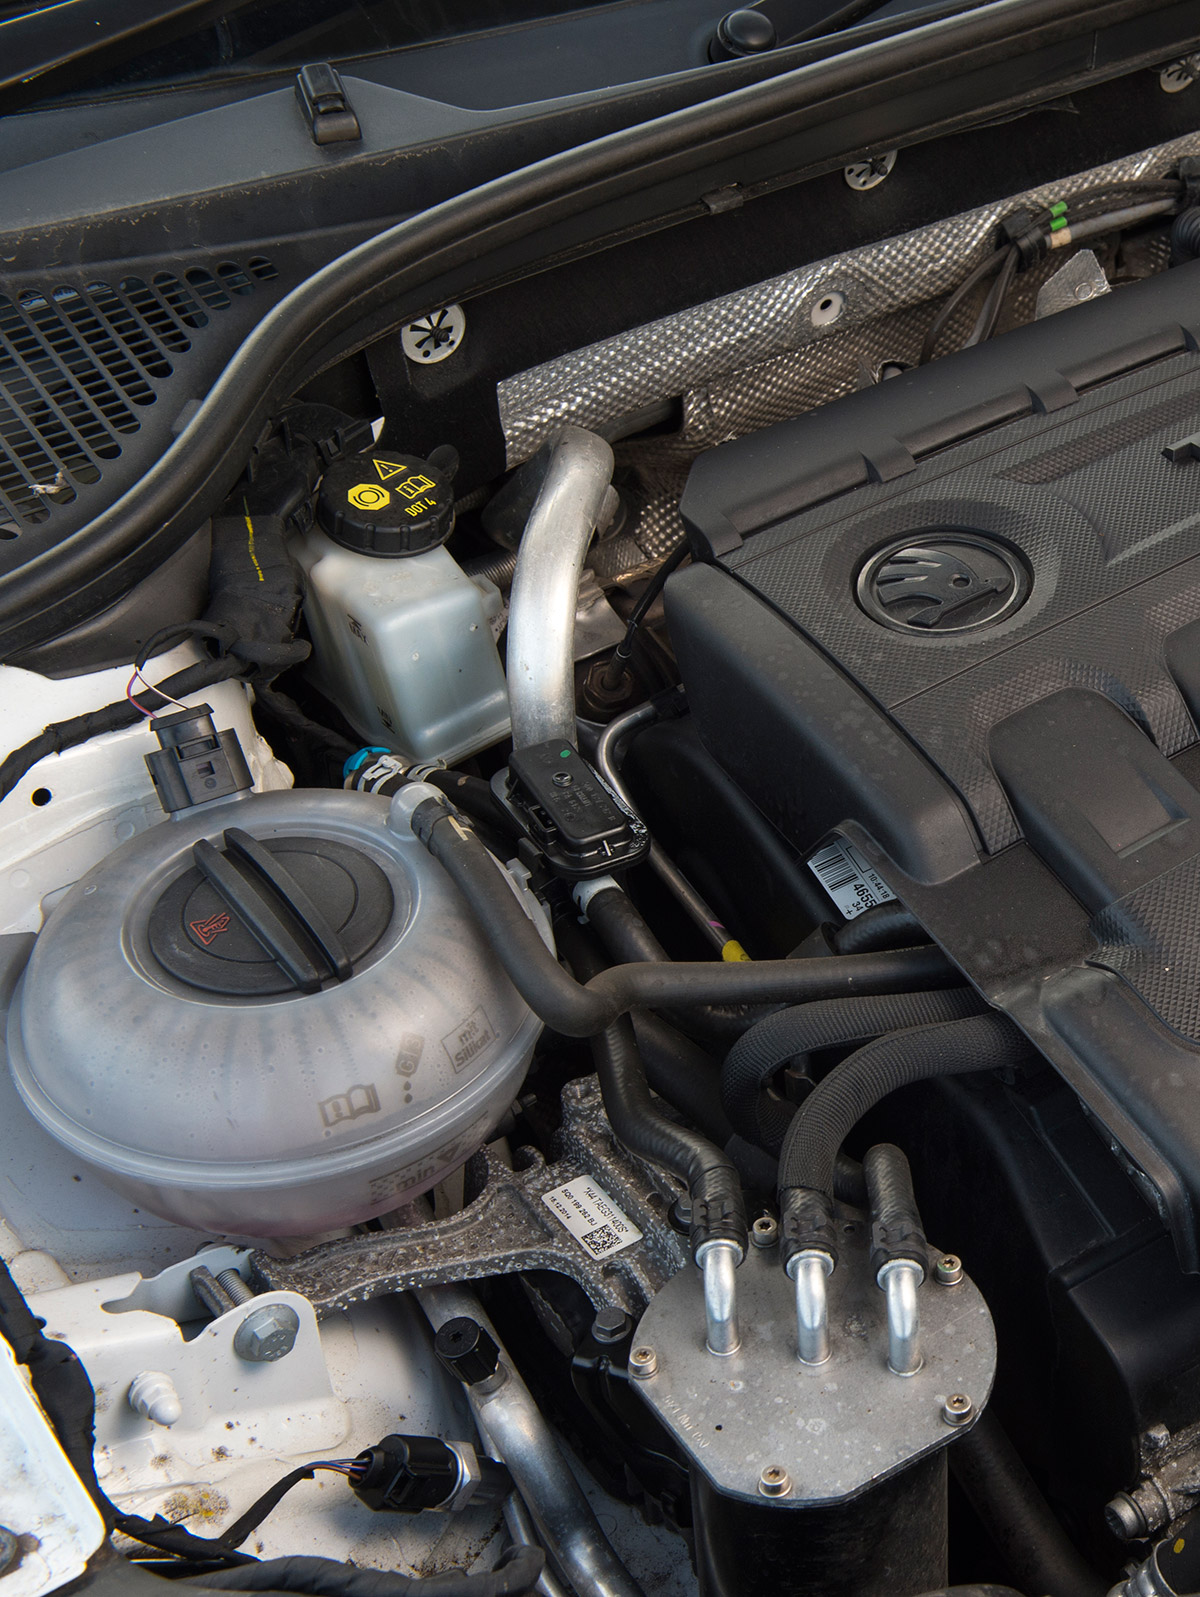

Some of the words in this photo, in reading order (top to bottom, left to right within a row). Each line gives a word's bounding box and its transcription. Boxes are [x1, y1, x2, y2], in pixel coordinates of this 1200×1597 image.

[405, 501, 428, 517] DOT
[424, 497, 437, 506] 4
[852, 901, 864, 912] 34
[853, 883, 878, 909] 4655
[454, 1029, 492, 1068] Silikat
